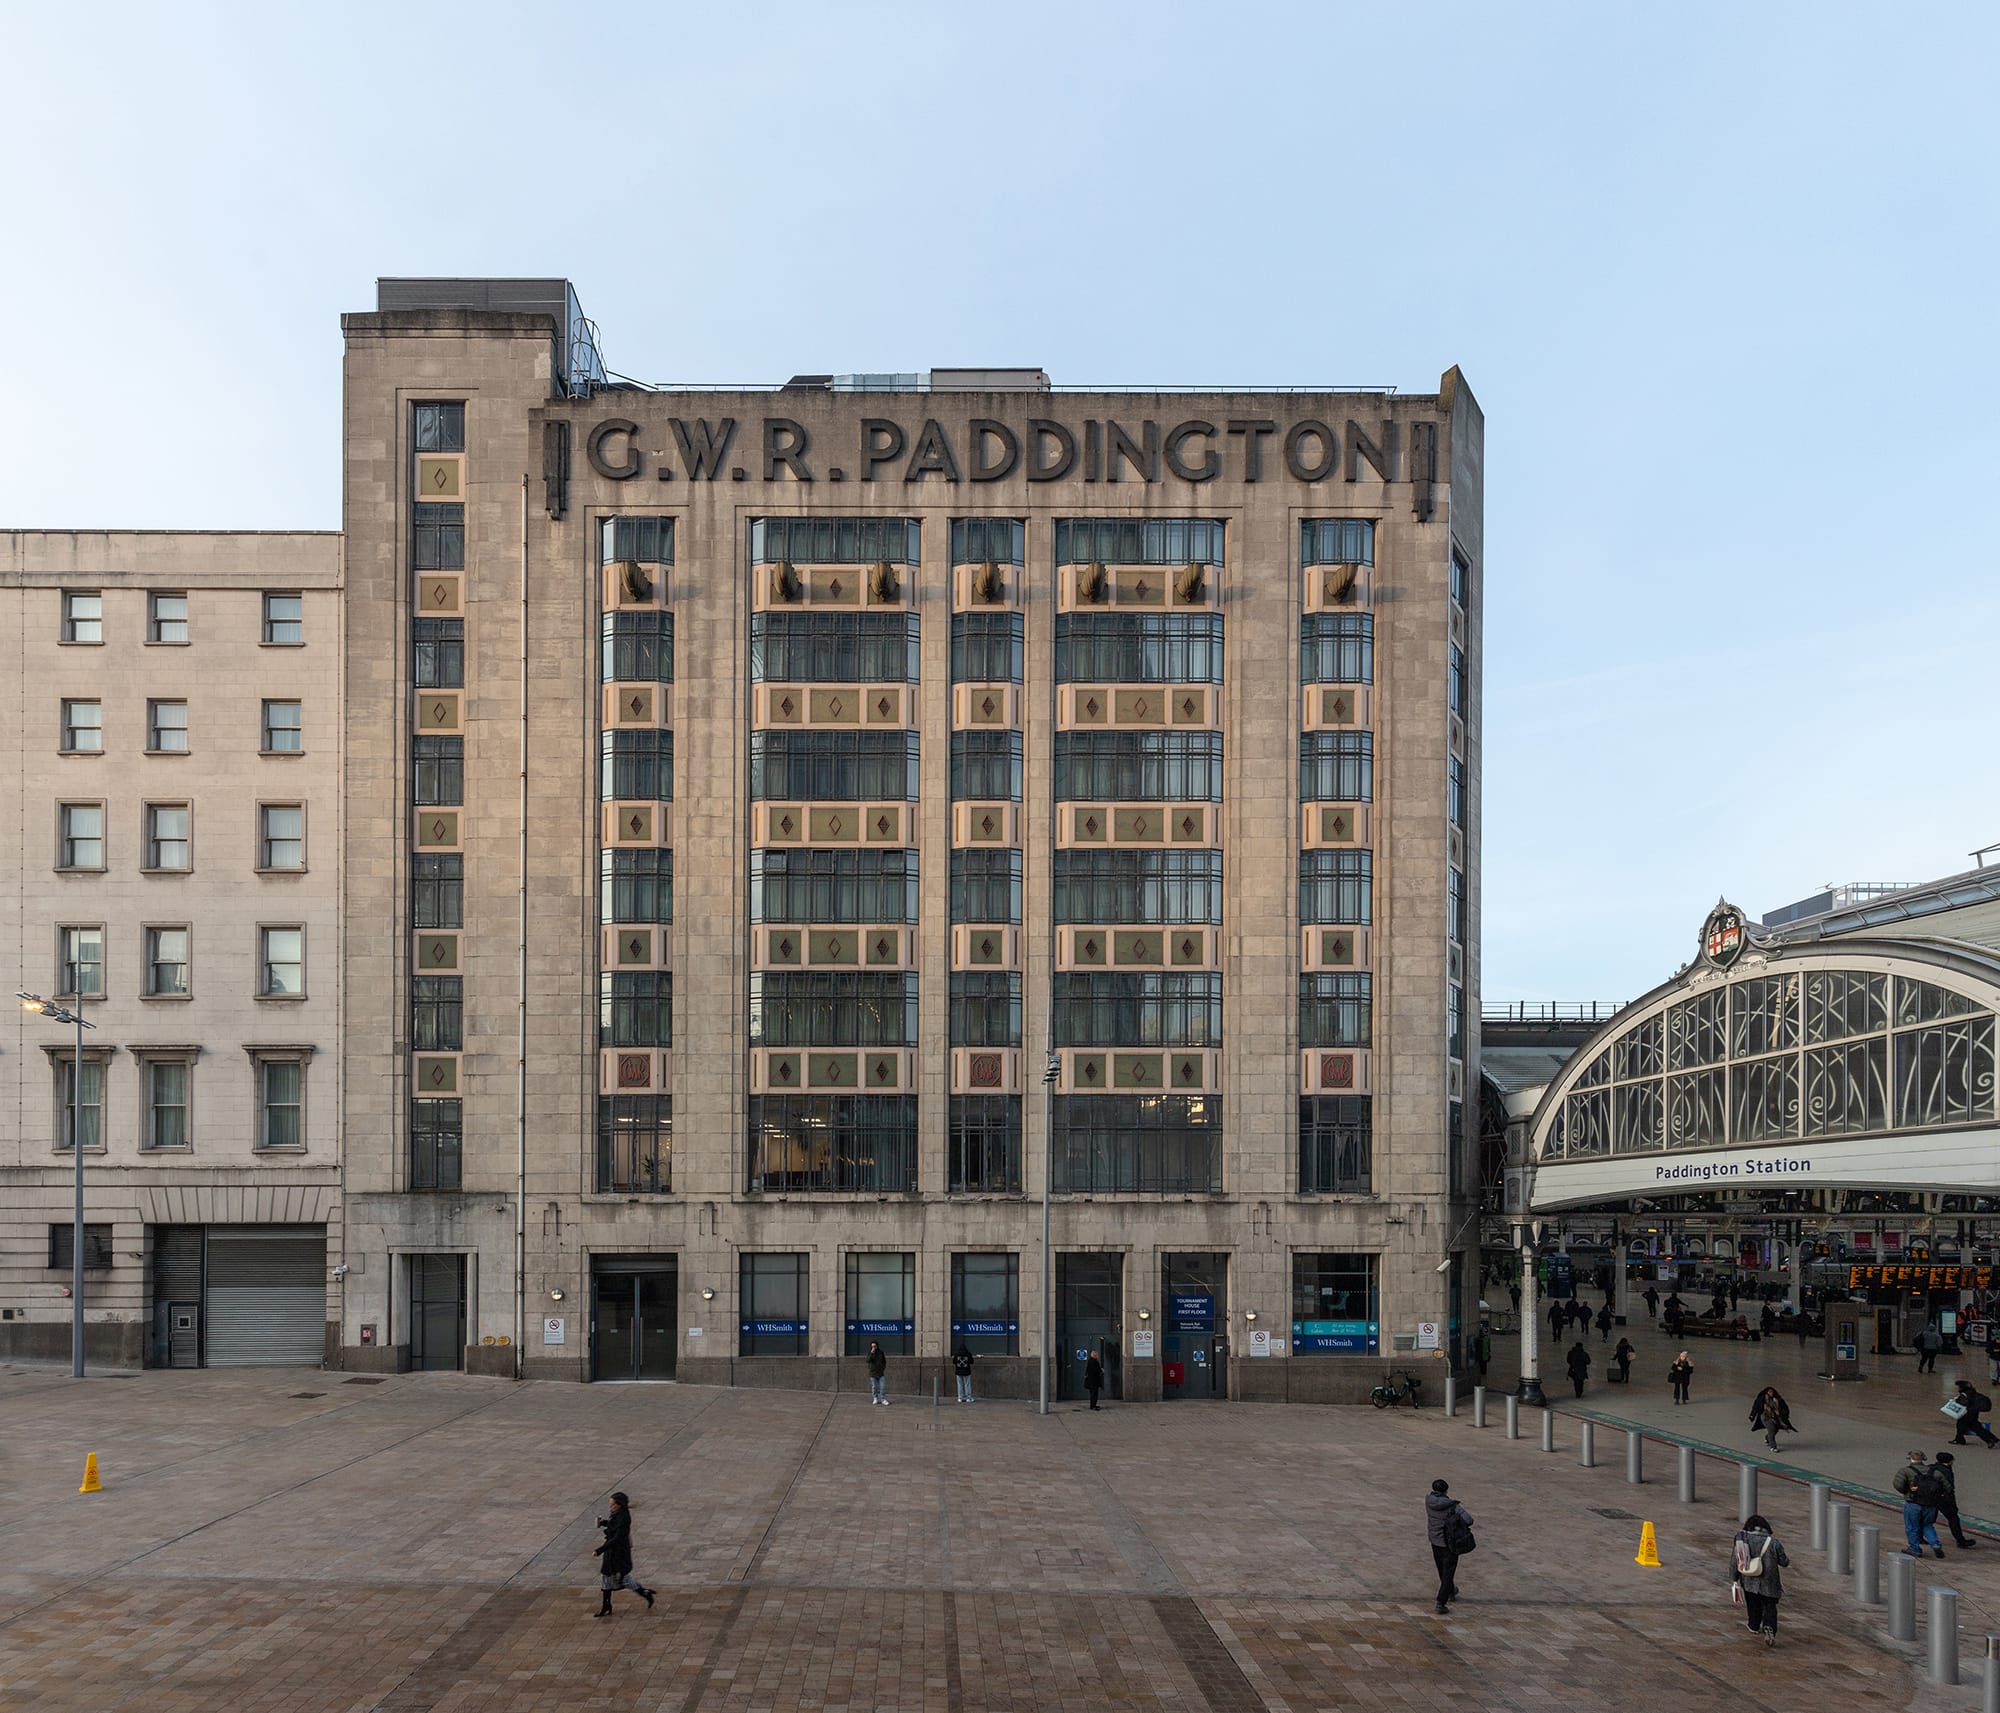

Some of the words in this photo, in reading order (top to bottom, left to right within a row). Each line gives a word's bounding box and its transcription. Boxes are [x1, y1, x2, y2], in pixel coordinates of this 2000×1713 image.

[861, 418, 1395, 483] PADDINGTON
[1656, 1163, 1738, 1179] Paddington
[1745, 1158, 1811, 1174] Station
[757, 1324, 793, 1332] WHSmith
[862, 1323, 898, 1331] WHSmith
[967, 1323, 1004, 1332] WHSmith
[1317, 1339, 1353, 1347] WHSmith
